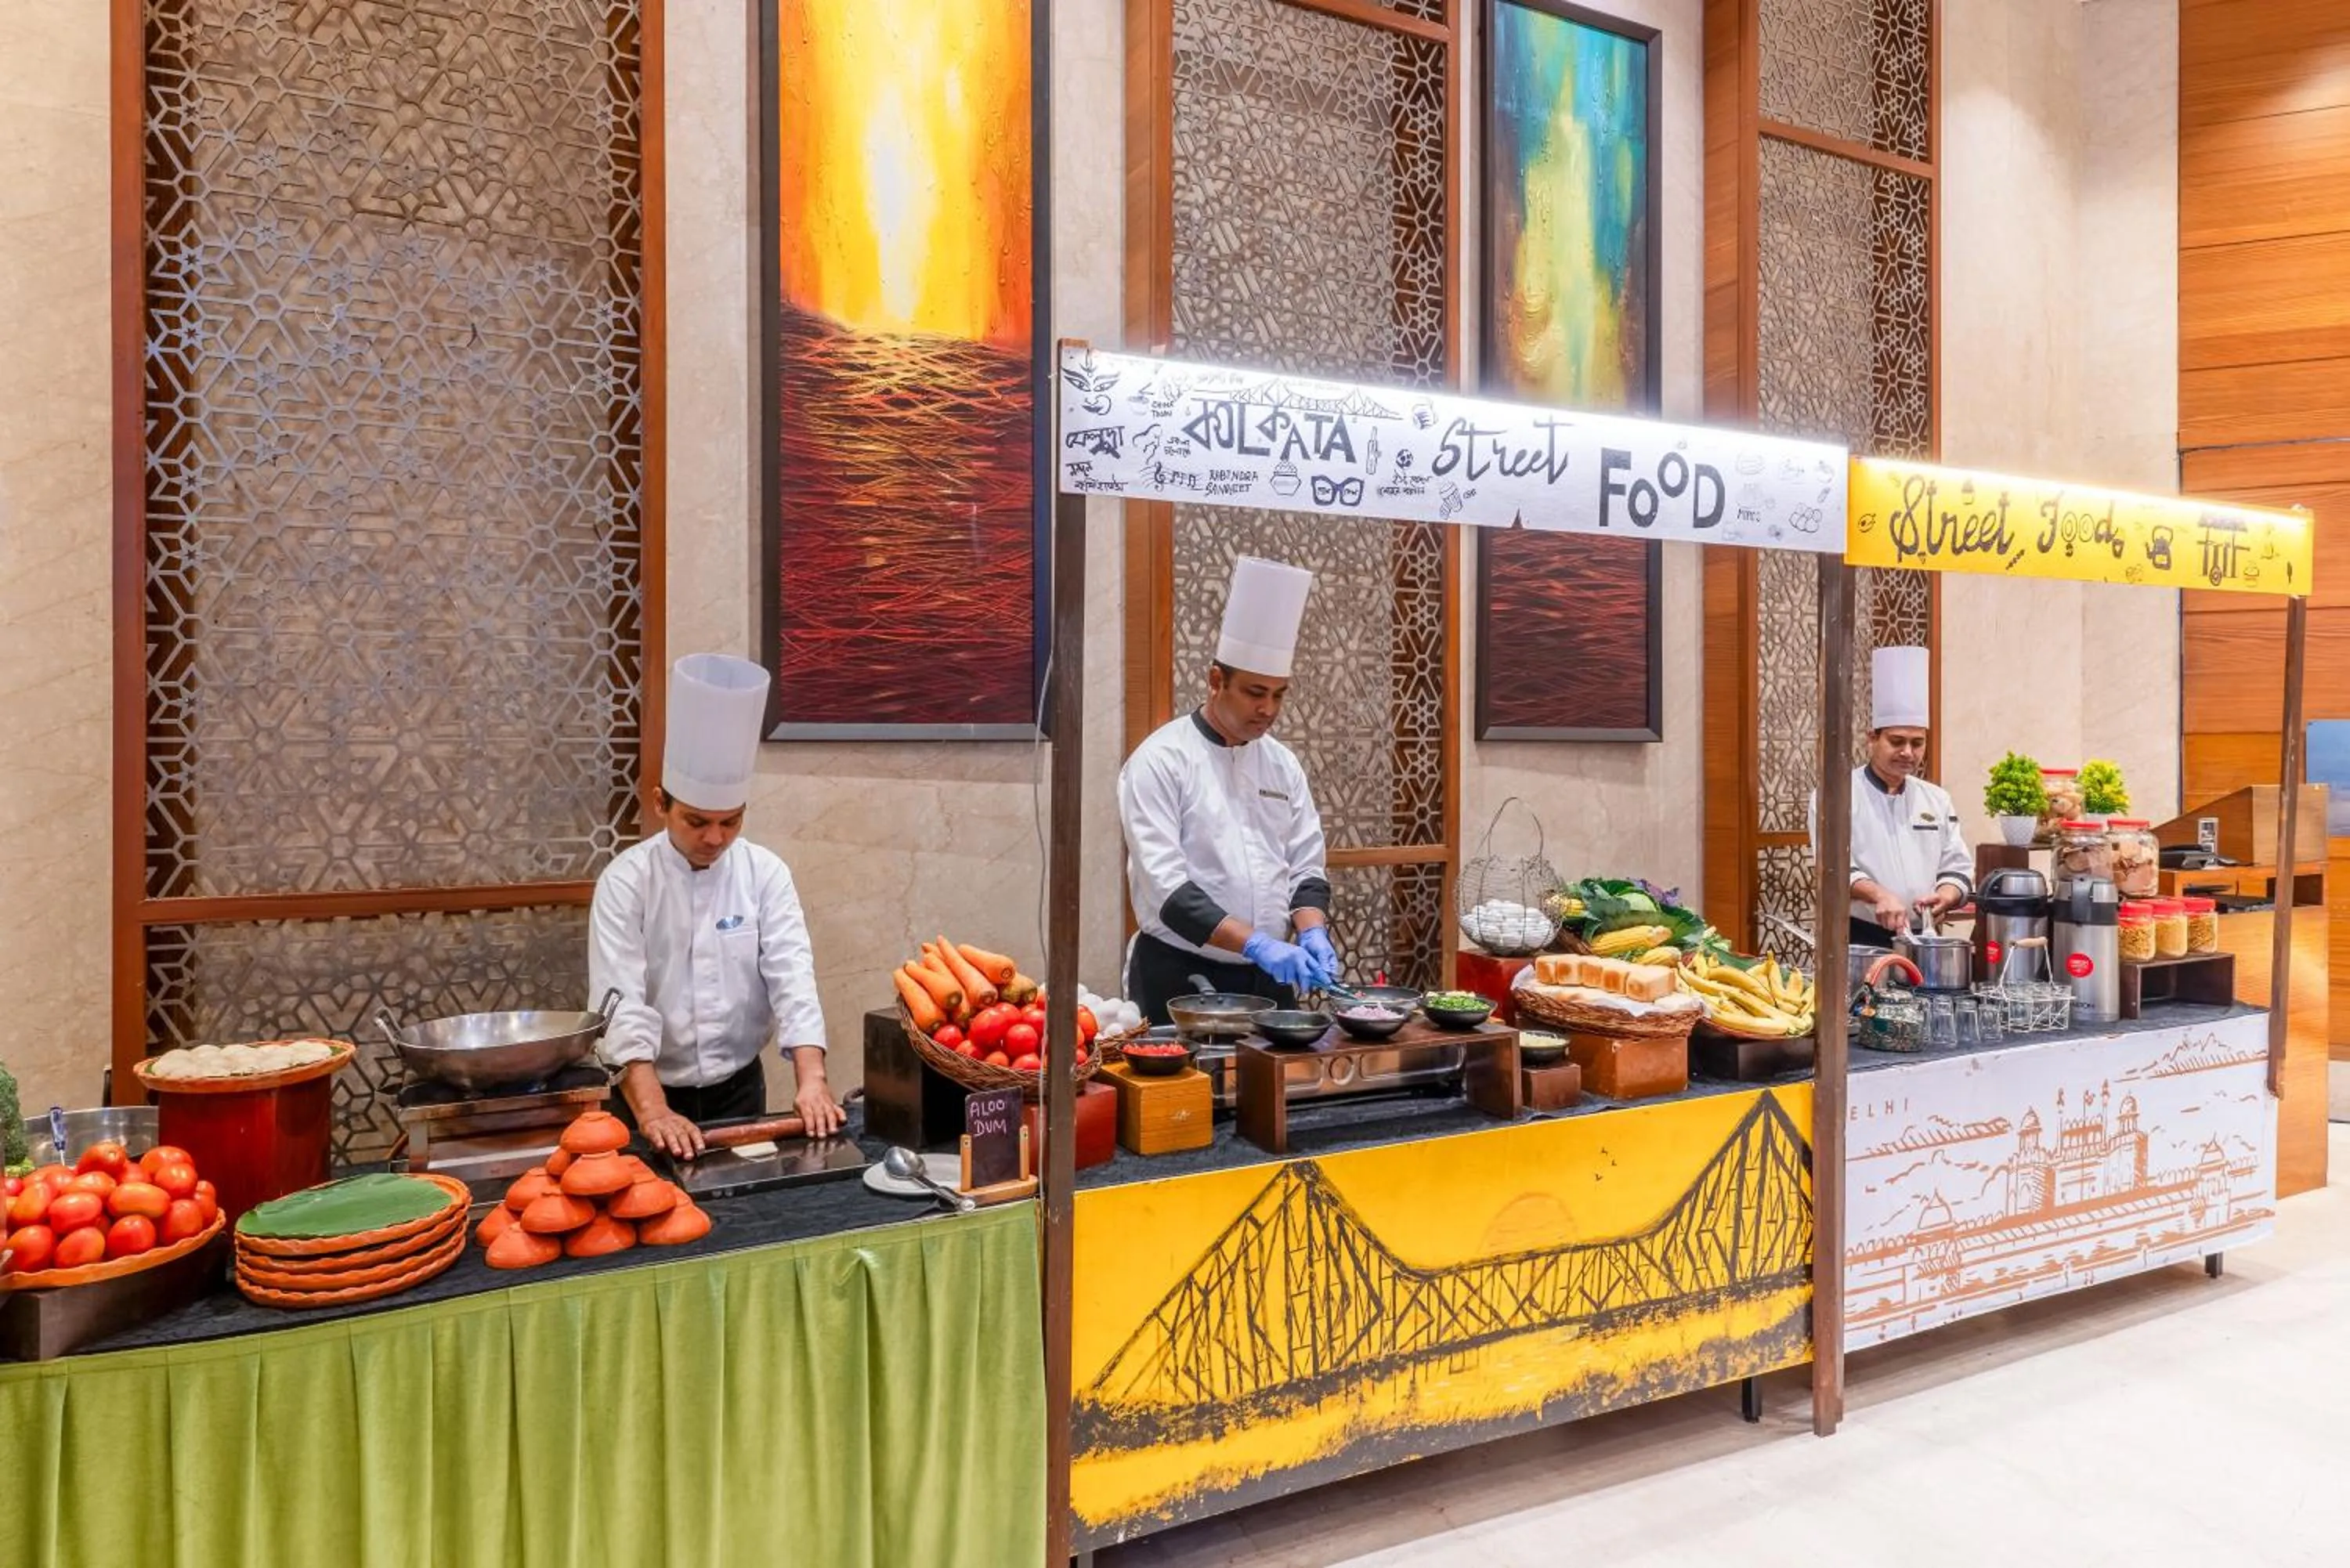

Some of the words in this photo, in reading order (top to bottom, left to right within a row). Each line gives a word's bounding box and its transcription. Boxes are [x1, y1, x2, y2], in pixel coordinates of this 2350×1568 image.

[1431, 415, 1574, 484] Street
[1599, 447, 1725, 528] FOOD
[1889, 474, 2016, 563] Street
[2037, 491, 2120, 555] Food
[970, 1099, 1005, 1118] ALOO
[1849, 1097, 1908, 1121] ELHI
[974, 1118, 1007, 1137] DUM
